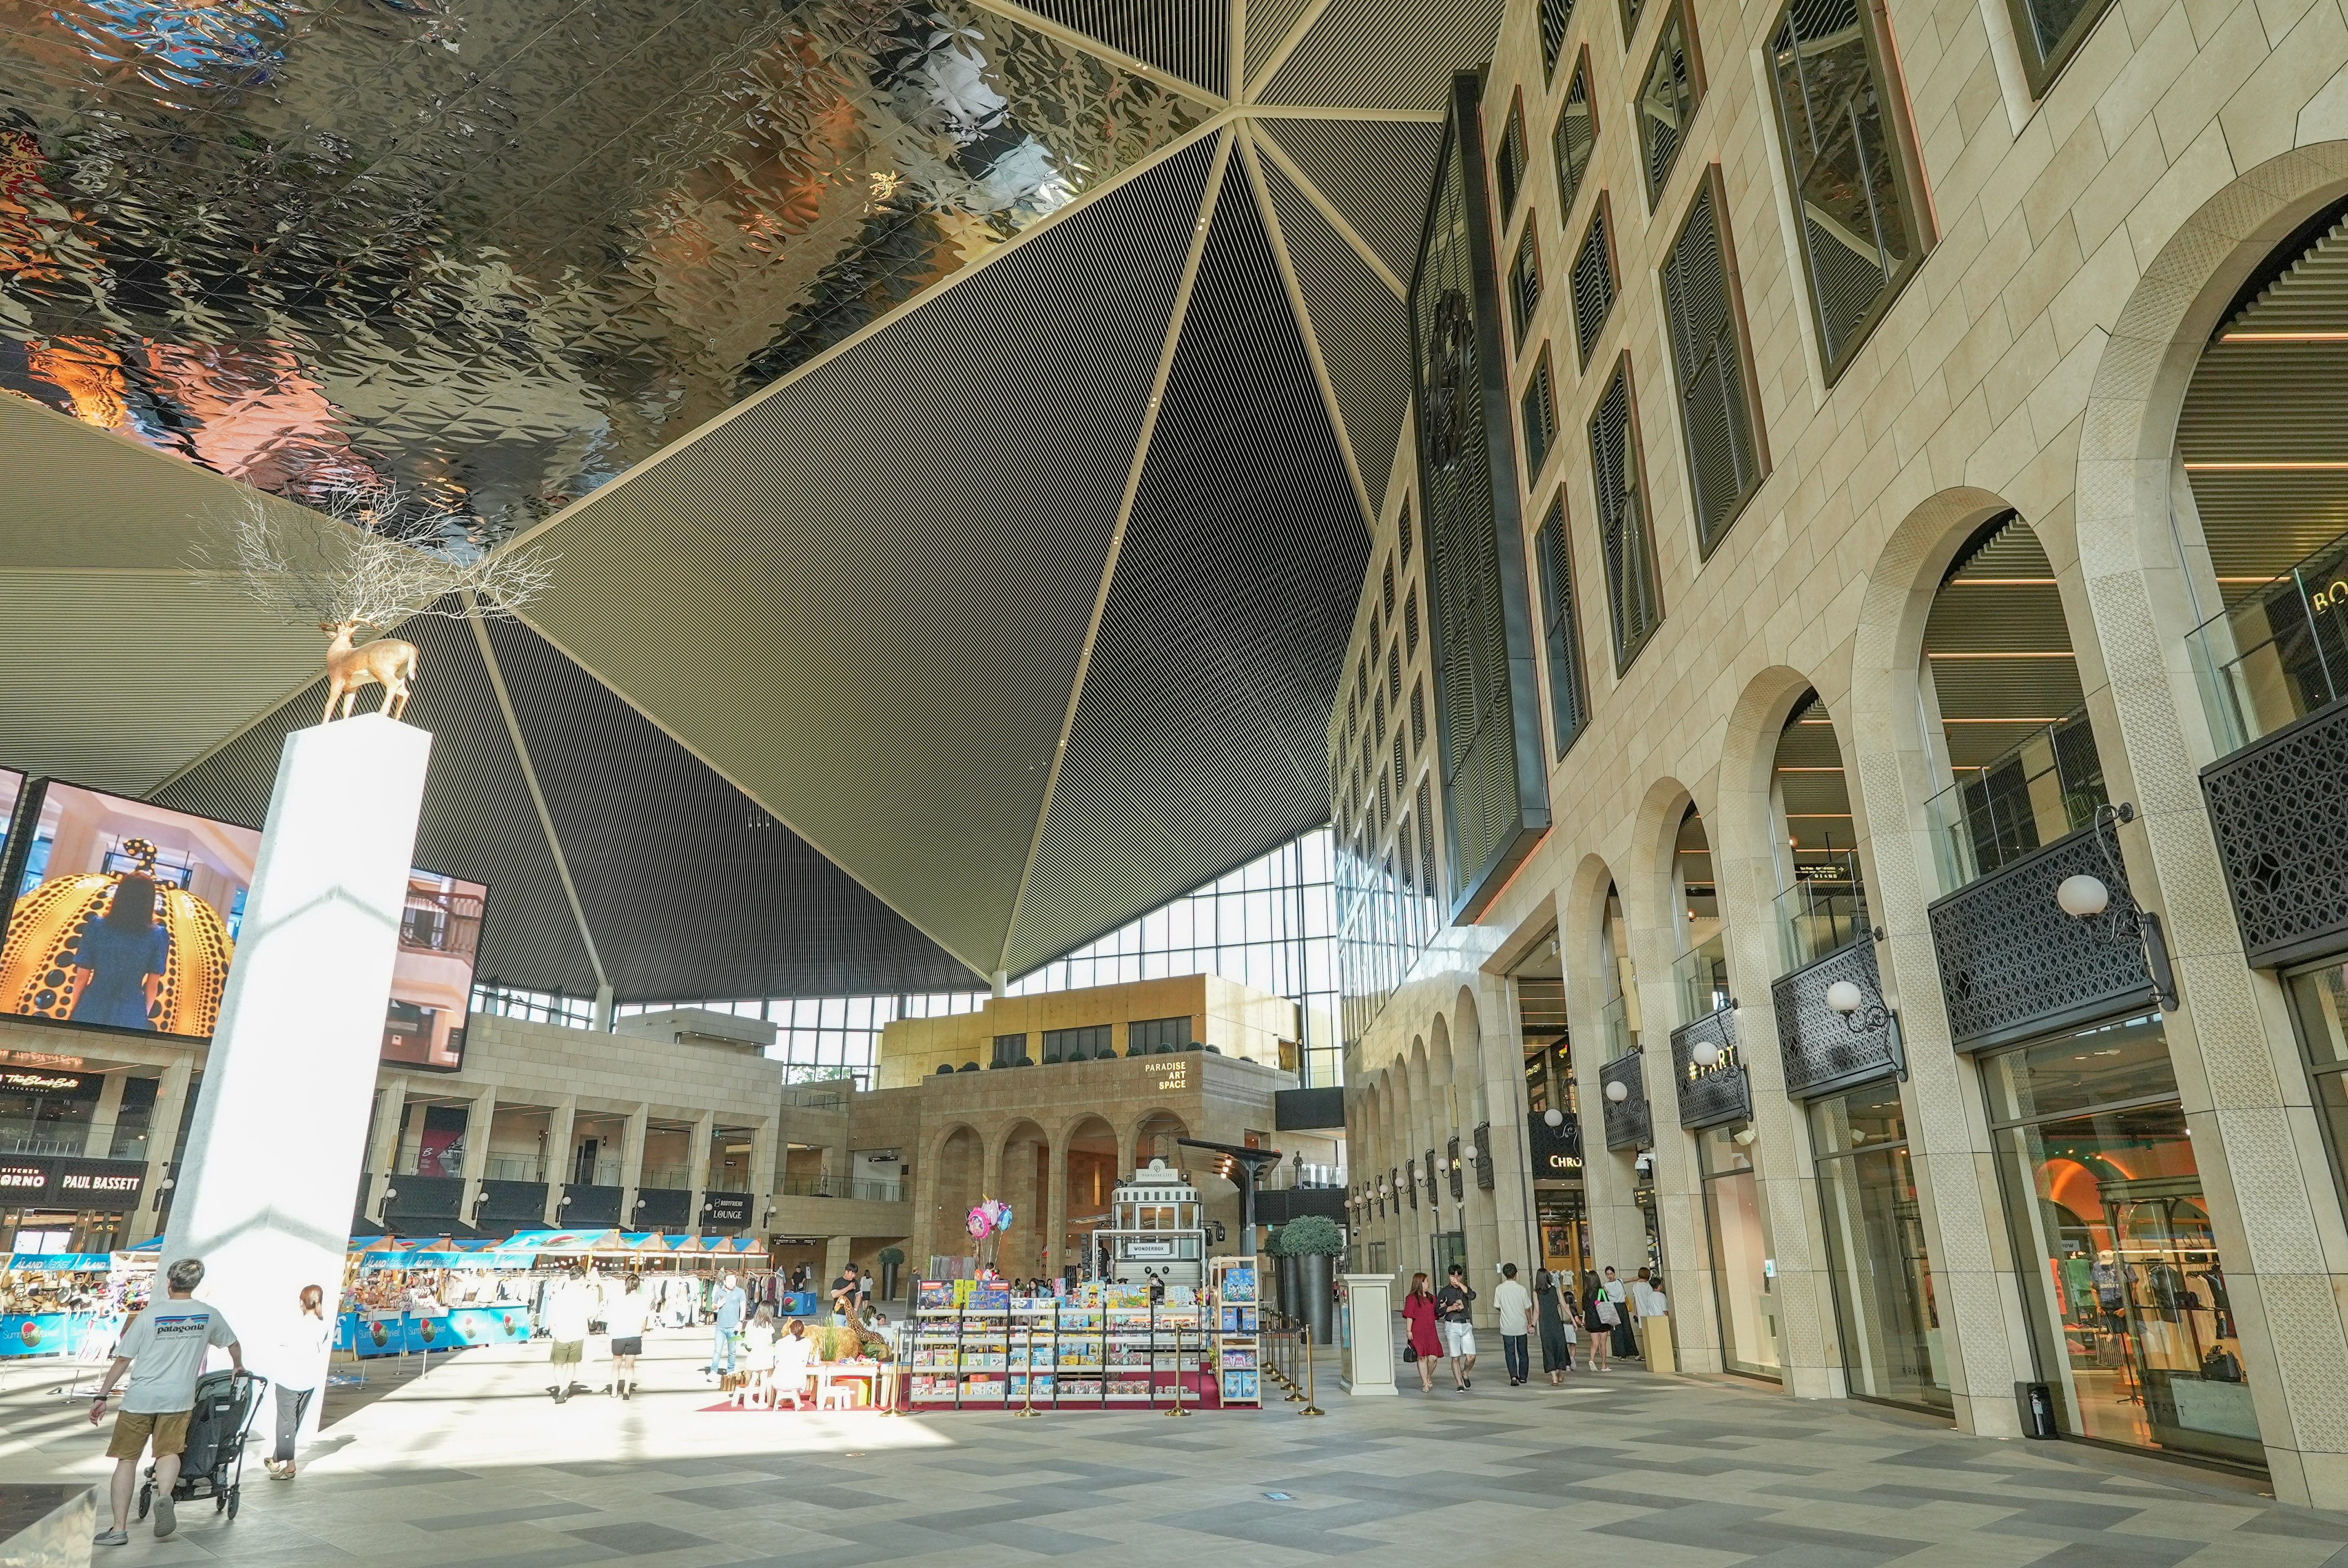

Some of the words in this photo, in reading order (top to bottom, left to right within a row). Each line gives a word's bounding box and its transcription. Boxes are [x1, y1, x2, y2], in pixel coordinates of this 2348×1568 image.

[1145, 1061, 1186, 1072] PARADISE
[1168, 1071, 1186, 1080] ART
[1159, 1080, 1186, 1090] SPACE
[0, 1174, 45, 1187] ORNO
[62, 1175, 91, 1189] PAUL
[92, 1175, 140, 1190] BASSETT
[713, 1210, 743, 1219] LOUNGE
[157, 1323, 204, 1334] patagonia
